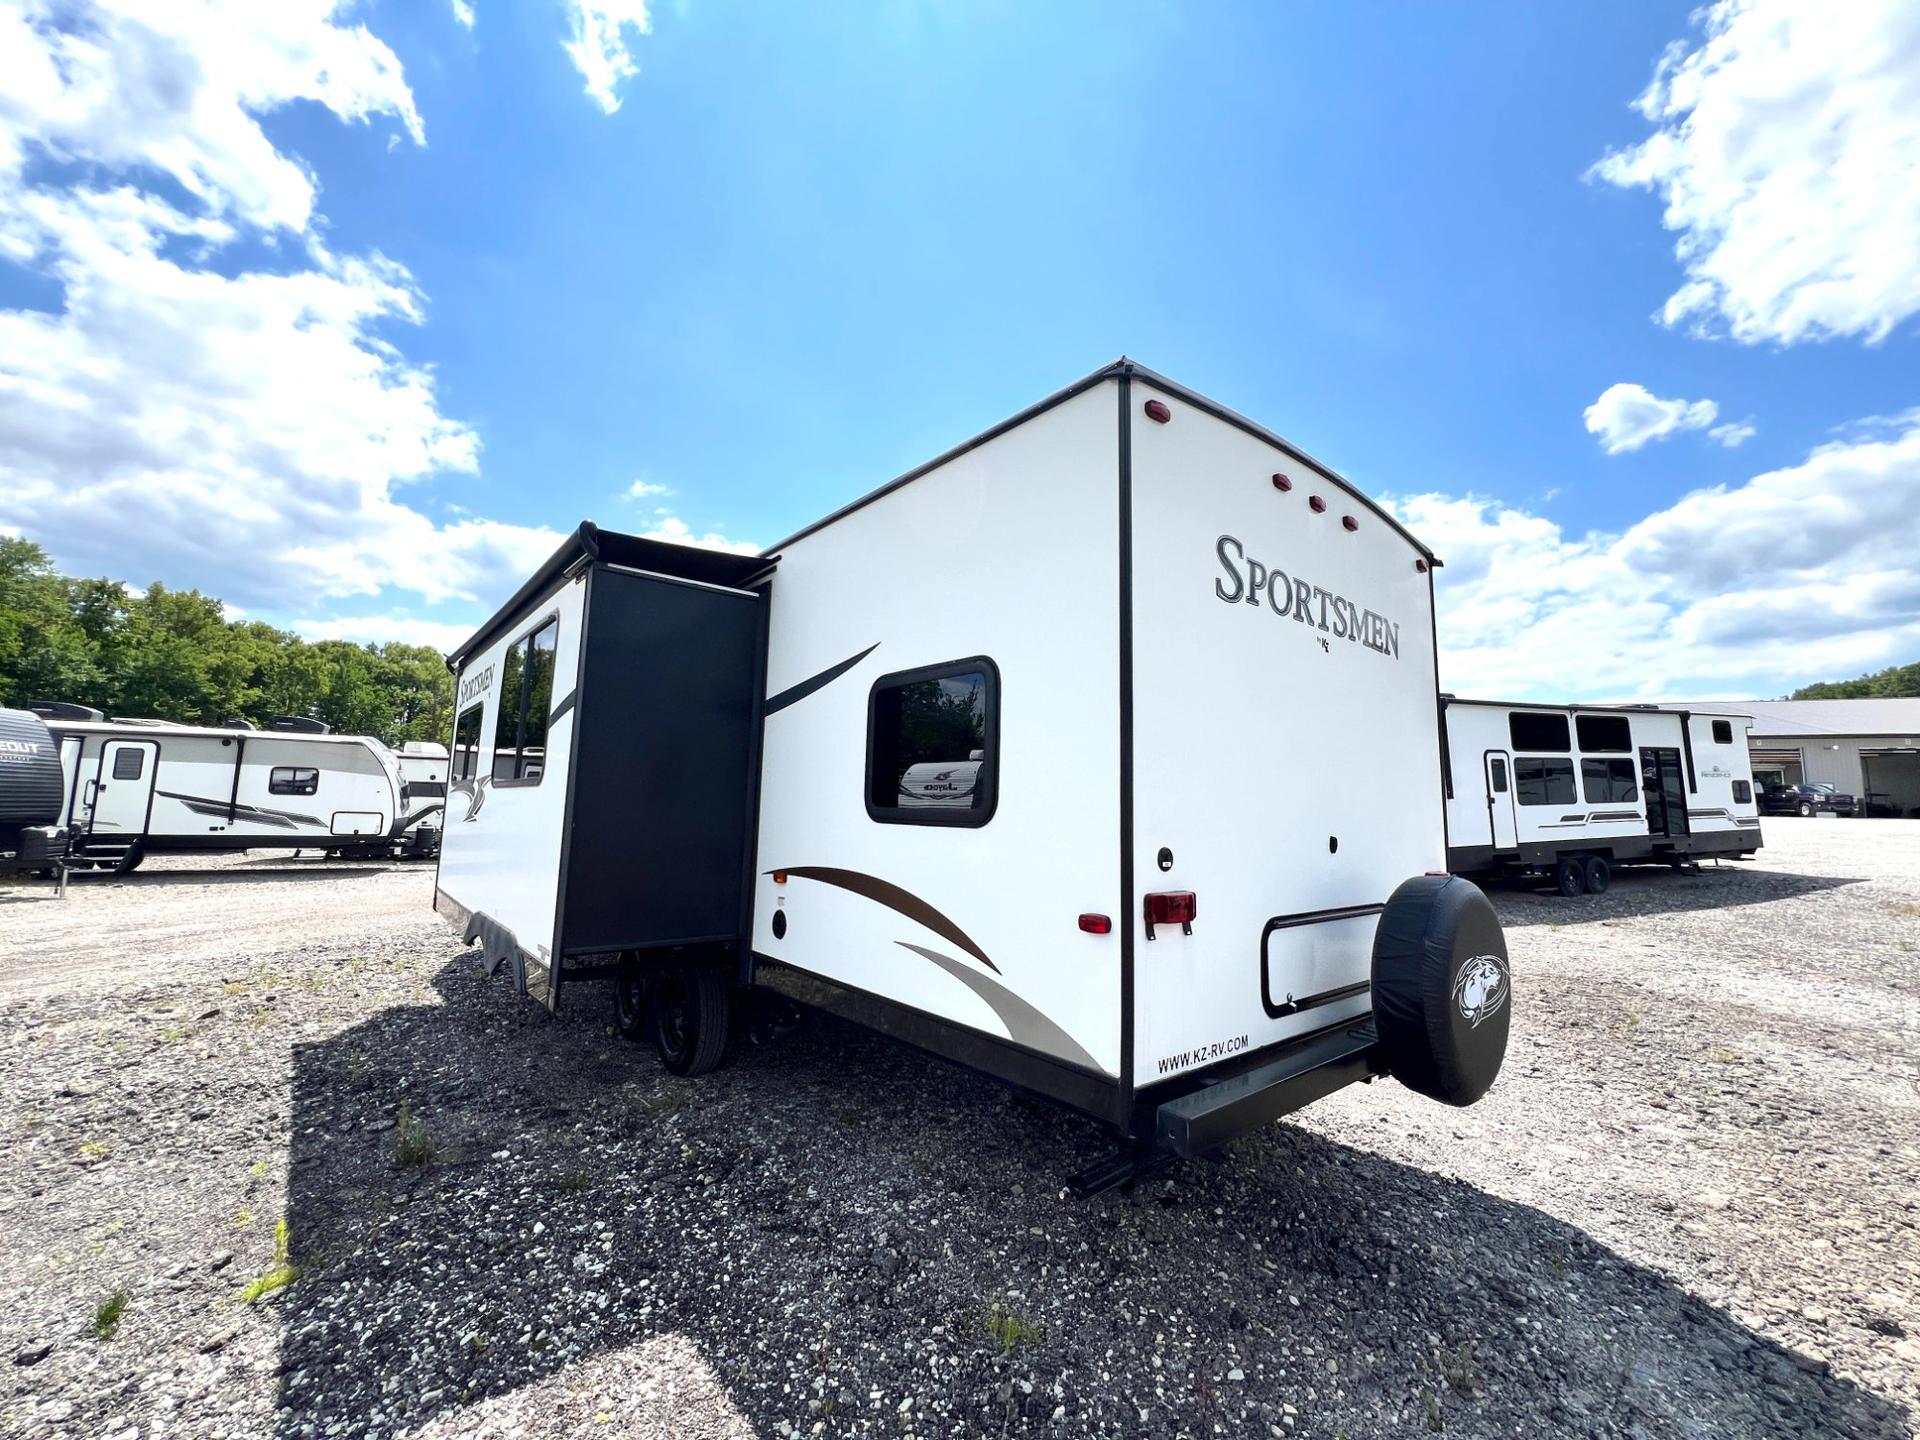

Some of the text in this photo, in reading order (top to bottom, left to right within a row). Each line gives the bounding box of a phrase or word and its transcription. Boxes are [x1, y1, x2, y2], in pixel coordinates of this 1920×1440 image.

[1215, 534, 1399, 661] SPORTSMEN
[460, 662, 495, 708] SPORTSMEN
[1158, 1034, 1249, 1074] WWW.KZ-RV.COM
